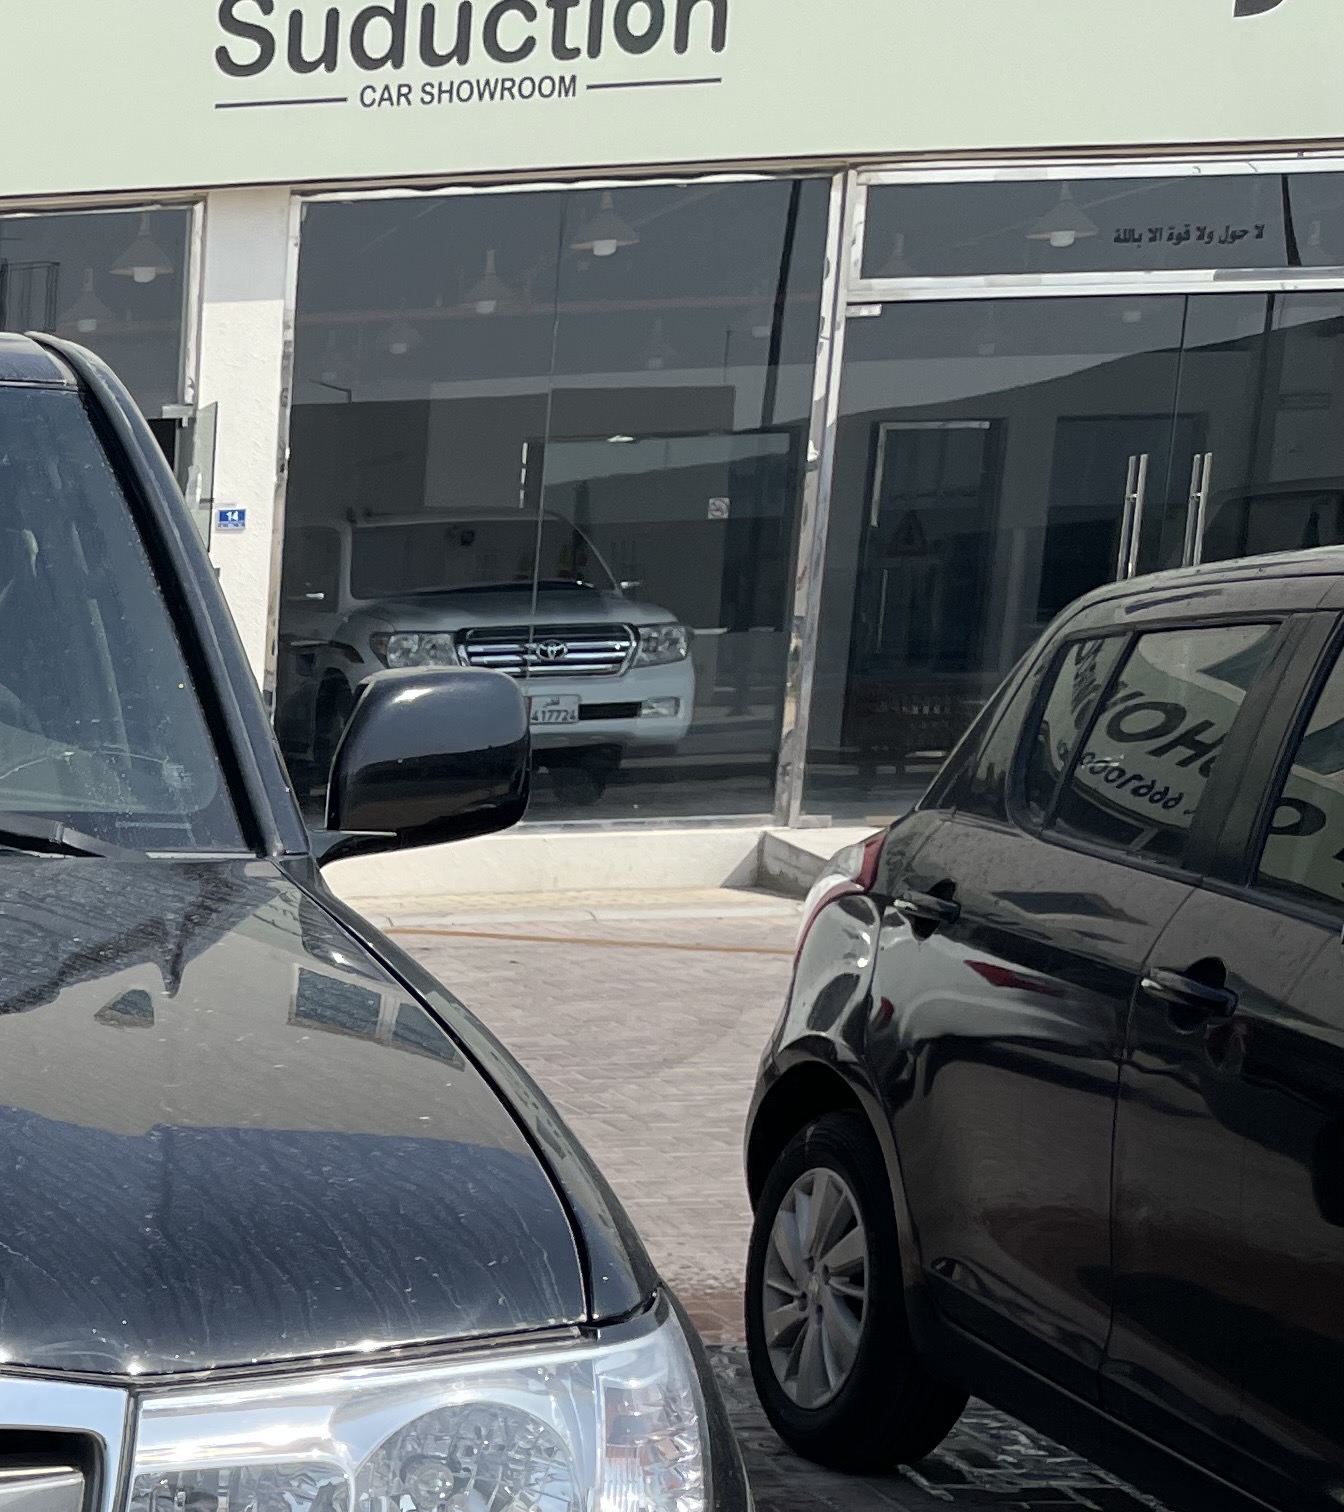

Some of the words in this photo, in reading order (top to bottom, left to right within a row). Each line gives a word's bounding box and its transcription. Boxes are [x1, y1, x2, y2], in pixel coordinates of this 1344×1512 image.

[213, 0, 729, 77] Suduction
[358, 82, 412, 109] CAR
[420, 74, 578, 104] SHOWROOM
[1196, 225, 1214, 245] ولا
[1218, 224, 1249, 244] حول
[1254, 223, 1265, 239] لا
[226, 511, 238, 521] 14
